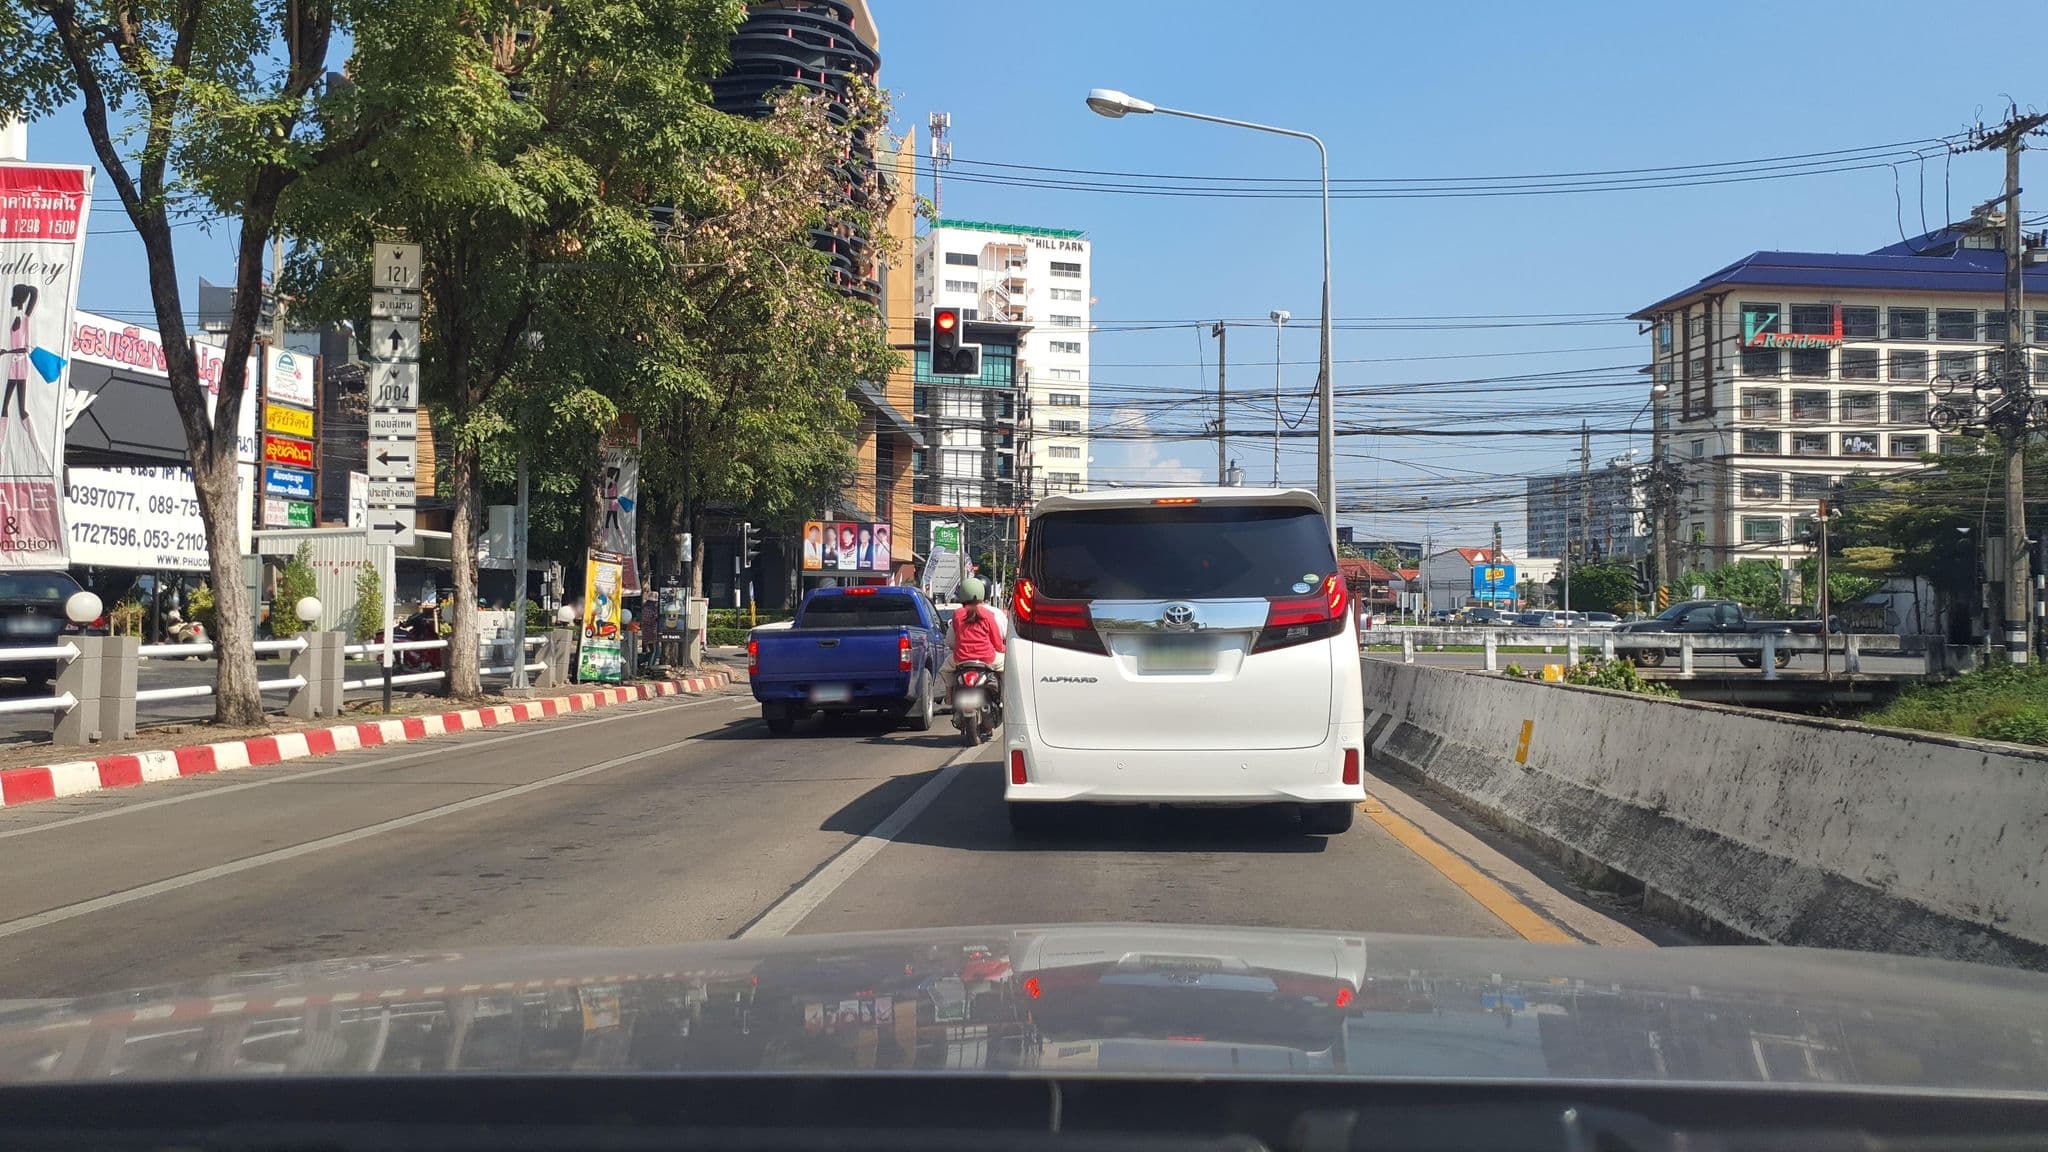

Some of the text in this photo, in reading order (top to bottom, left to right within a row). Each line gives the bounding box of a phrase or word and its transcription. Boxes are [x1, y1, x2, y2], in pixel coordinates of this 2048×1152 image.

[0, 186, 77, 211] าคาเริ่มต้น
[1035, 240, 1056, 250] HILL
[1059, 240, 1083, 252] PARK
[0, 253, 68, 286] allery
[387, 265, 407, 283] 121
[379, 384, 410, 402] 1004
[0, 487, 50, 512] ALE
[4, 515, 20, 536] &
[0, 537, 58, 553] motion
[157, 555, 211, 567] WWW.PHUCO
[1040, 675, 1098, 684] ALPHARD
